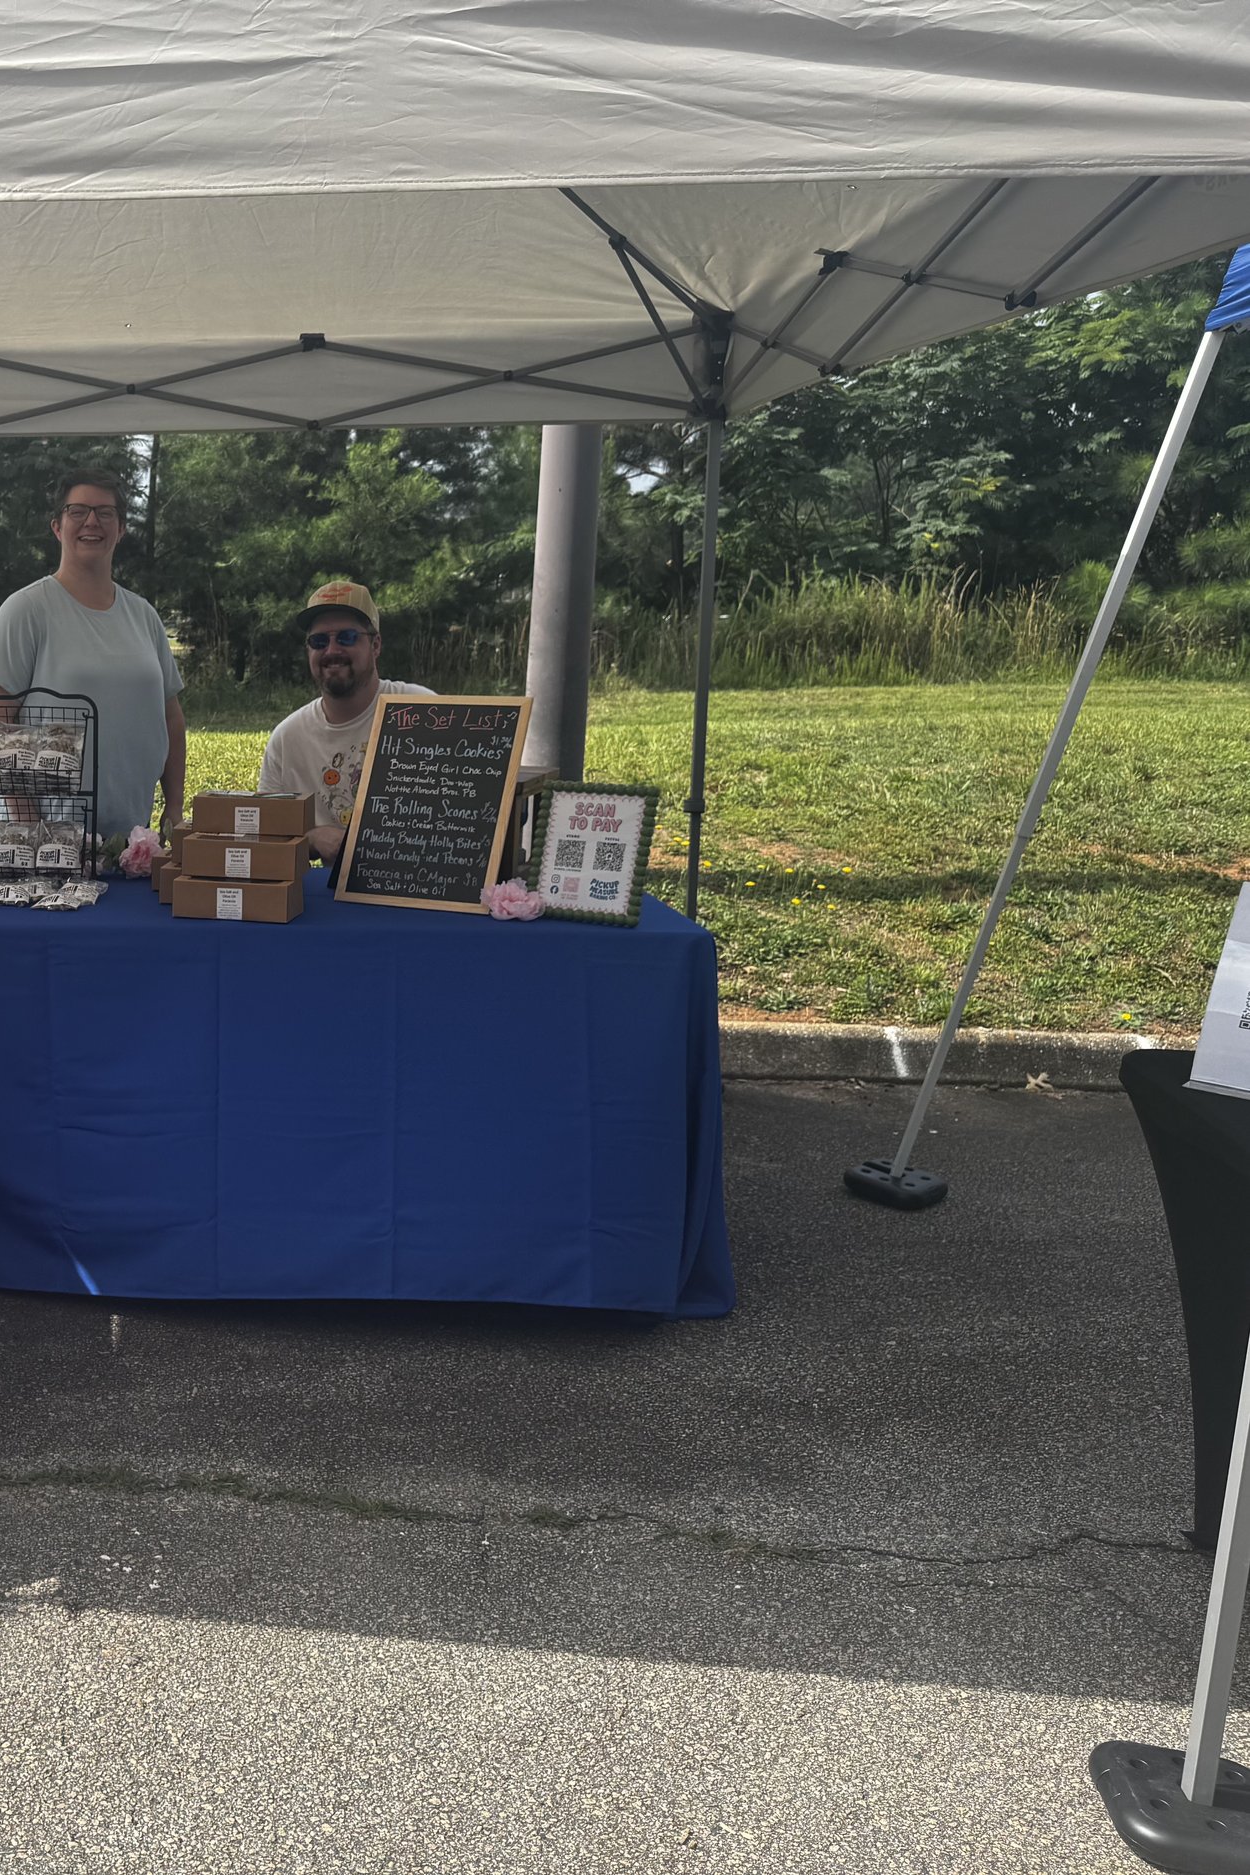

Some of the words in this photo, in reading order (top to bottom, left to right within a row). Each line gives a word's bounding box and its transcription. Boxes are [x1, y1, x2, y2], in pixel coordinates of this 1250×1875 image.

[391, 706, 420, 727] The
[425, 706, 456, 729] Set
[462, 708, 503, 728] List
[381, 735, 402, 755] Hit
[404, 737, 451, 760] Singles
[454, 739, 504, 760] Cookies
[390, 759, 417, 770] Brown
[419, 761, 439, 775] Eyed
[441, 764, 459, 775] Girl
[485, 767, 502, 778] Chip
[386, 772, 436, 785] Snickerdoodle
[411, 785, 439, 795] Almond
[462, 788, 477, 798] PB
[371, 796, 390, 814] The
[393, 796, 433, 823] Rolling
[437, 799, 478, 820] Scones
[575, 802, 616, 818] SCAN
[381, 815, 406, 827] Cookies
[411, 819, 433, 830] Cream
[569, 816, 588, 830] TO
[591, 817, 623, 833] PAY
[362, 828, 395, 849] Muddy
[397, 831, 427, 854] Buddy
[430, 835, 454, 853] Holly
[456, 838, 481, 850] Bites
[366, 849, 390, 860] Want
[442, 851, 473, 867] Pecans
[356, 863, 401, 880] Focaccia
[404, 873, 414, 881] in
[367, 879, 381, 889] Sea
[384, 880, 401, 891] Salt
[408, 883, 429, 894] Olive
[431, 886, 446, 897] Oil
[590, 878, 620, 889] PICKUP
